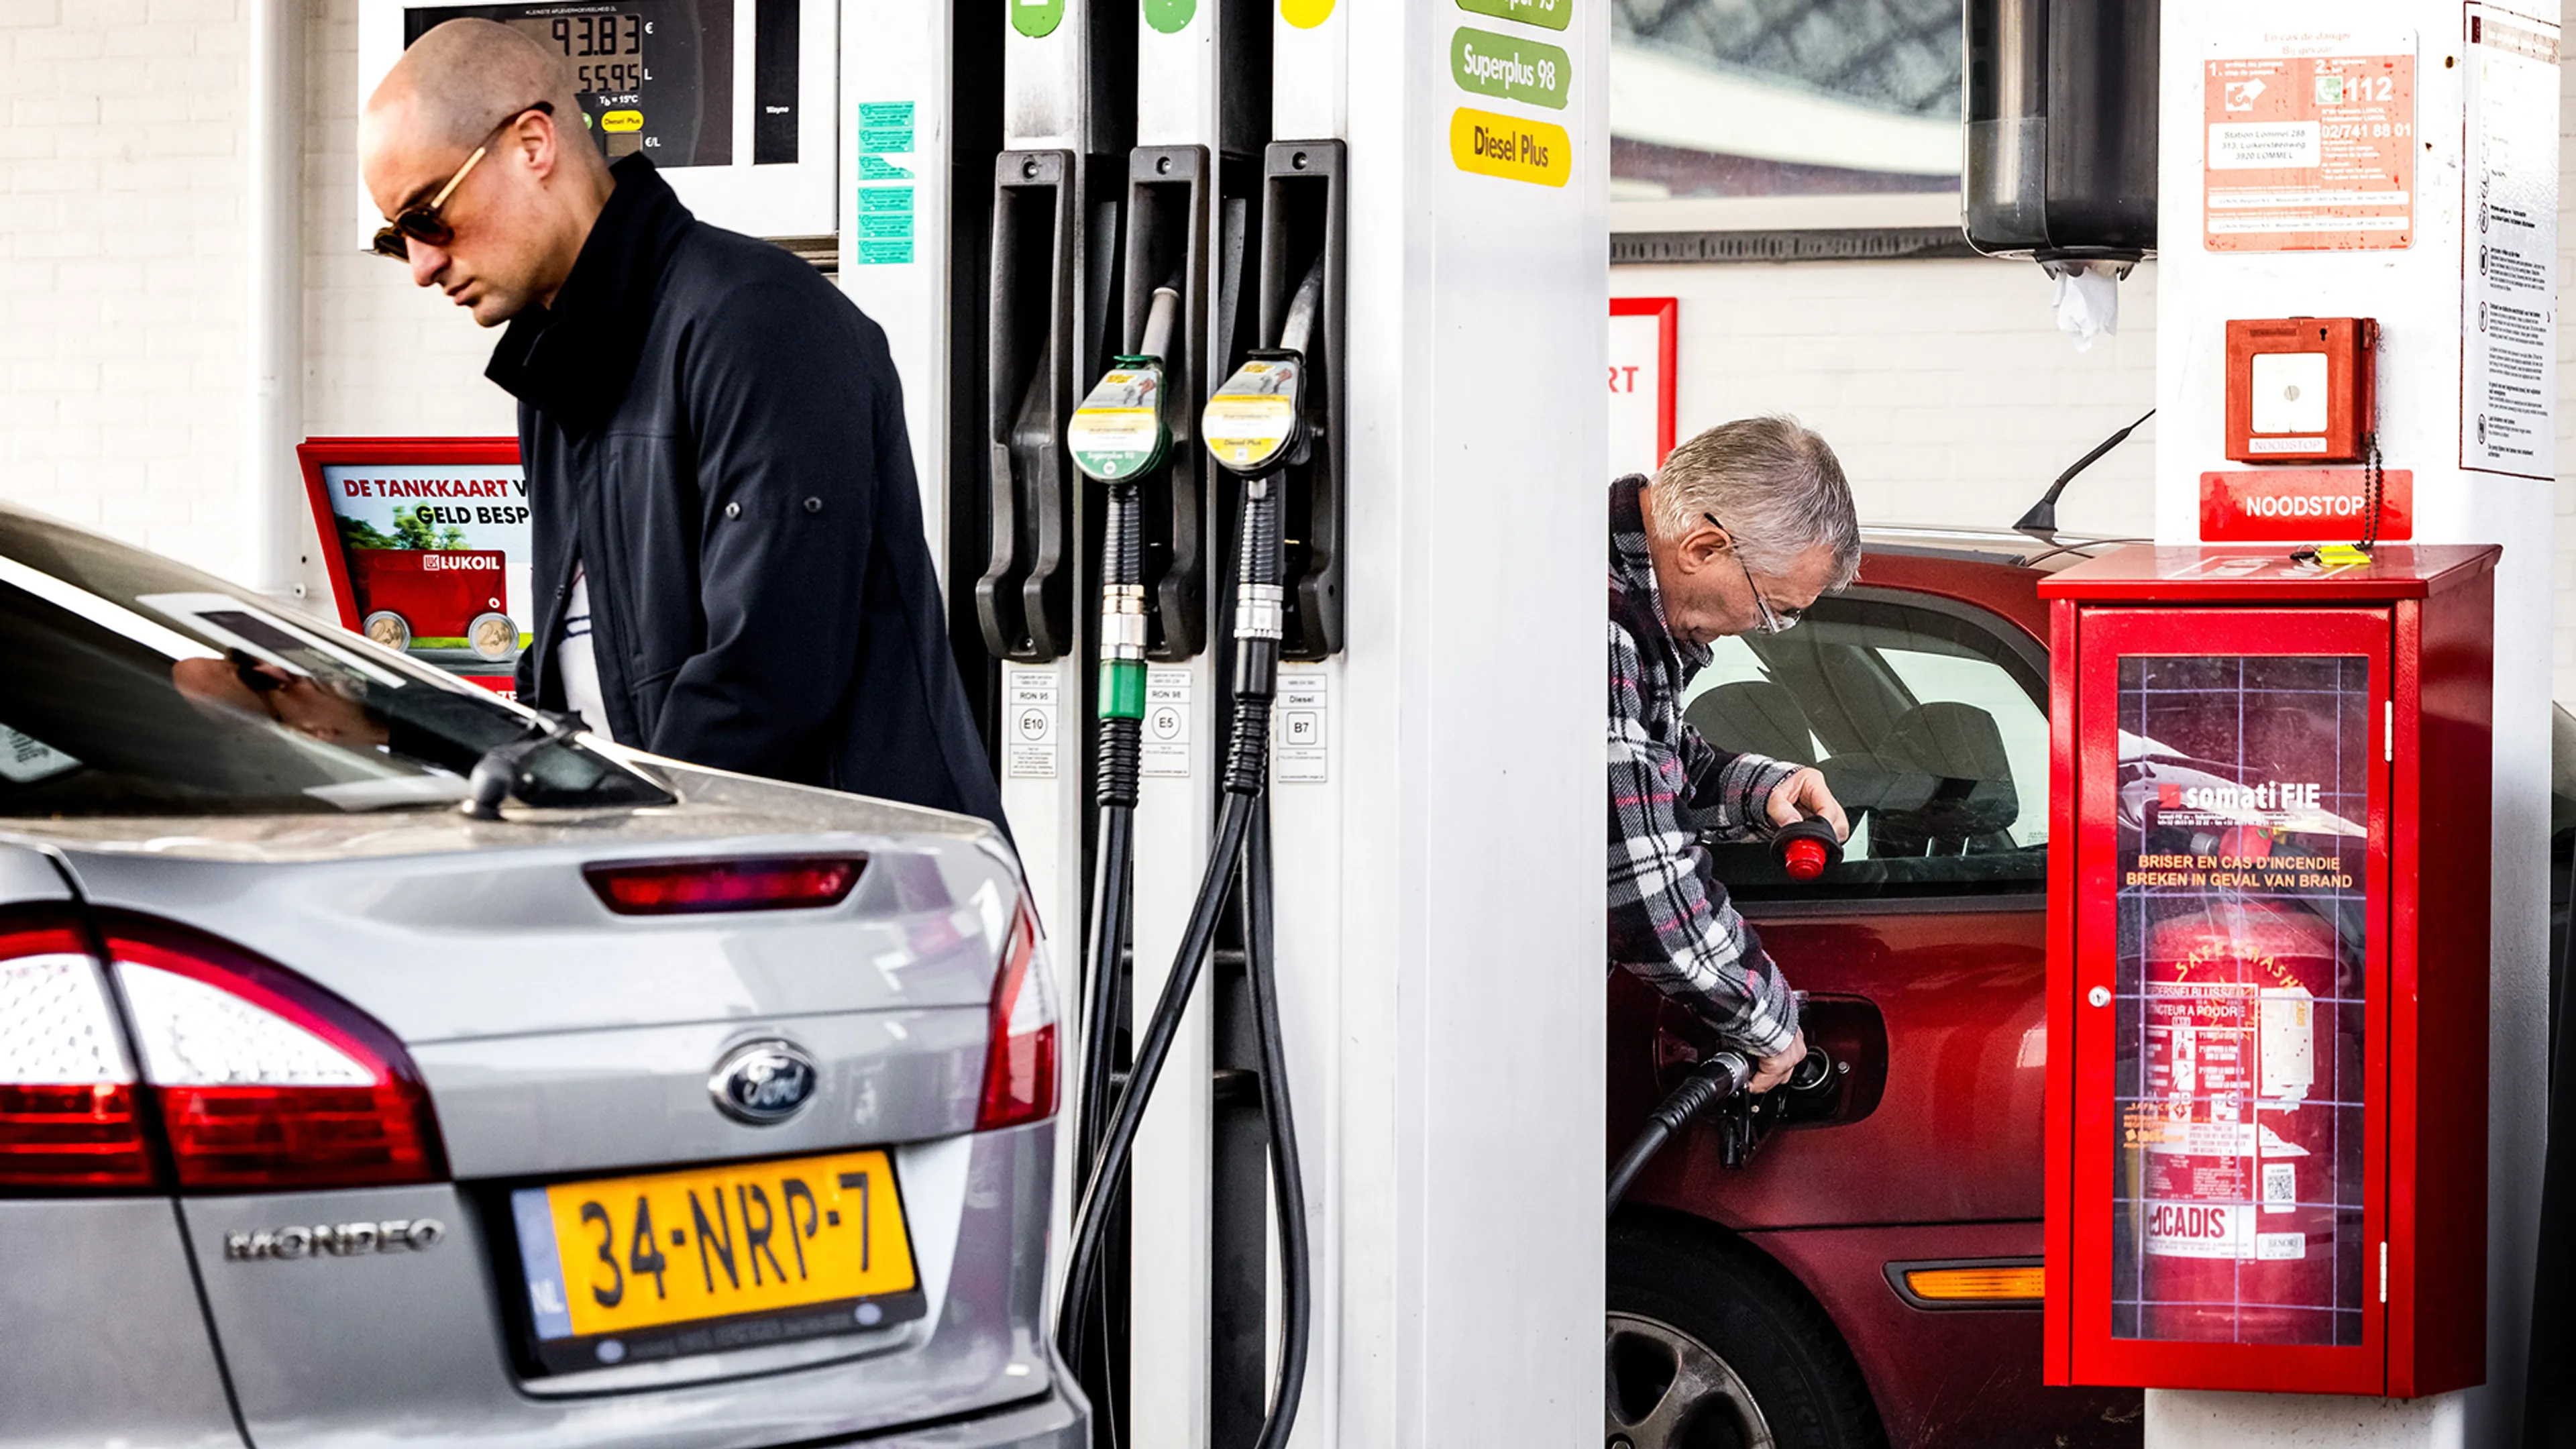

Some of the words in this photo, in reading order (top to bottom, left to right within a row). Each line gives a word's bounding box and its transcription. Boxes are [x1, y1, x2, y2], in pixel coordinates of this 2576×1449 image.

[645, 21, 653, 34] €
[1464, 43, 1534, 90] Superplus
[1538, 59, 1556, 91] 98
[2208, 62, 2223, 76] 1.
[2316, 59, 2330, 73] 2.
[644, 68, 653, 80] L
[2346, 76, 2393, 101] 112
[766, 106, 790, 114] Wayne
[2224, 131, 2253, 139] Station
[2322, 124, 2368, 138] 02/741
[2373, 123, 2391, 138] 88
[2394, 123, 2412, 137] 01
[645, 136, 661, 148] €/L
[1474, 125, 1515, 161] Diesel
[1521, 134, 1548, 168] Plus
[2257, 151, 2293, 159] LOMMEL
[2255, 441, 2321, 450] NOODSTOP
[343, 480, 369, 497] DE
[374, 480, 508, 498] TANKKAART
[2246, 496, 2365, 517] NOODSTOP
[416, 506, 471, 525] GELD
[478, 506, 530, 525] BESP
[440, 556, 500, 570] LUKOIL
[1020, 692, 1038, 700] RON
[1039, 692, 1049, 700] 95
[1152, 690, 1170, 698] RON
[1173, 690, 1181, 698] 98
[1289, 695, 1315, 703] Diesel
[1024, 718, 1044, 730] E10
[1159, 717, 1174, 729] E5
[1294, 722, 1309, 733] B7
[2186, 780, 2276, 810] somati
[2281, 783, 2321, 809] FIE
[2139, 855, 2194, 869] BRISER
[2198, 855, 2218, 869] EN
[2221, 856, 2252, 869] CAS
[2257, 856, 2341, 871] D'INCENDIE
[2126, 872, 2188, 886] BREKEN
[2192, 873, 2206, 886] IN
[2210, 873, 2260, 887] GEVAL
[2263, 874, 2295, 888] VAN
[2299, 874, 2353, 888] BRAND
[2176, 941, 2226, 983] SAFE
[2197, 1005, 2245, 1018] POUDRE
[742, 1054, 806, 1106] Ford
[225, 1218, 447, 1262] MONDEO
[579, 1171, 870, 1309] 34-NRP-7
[530, 1281, 565, 1314] NL
